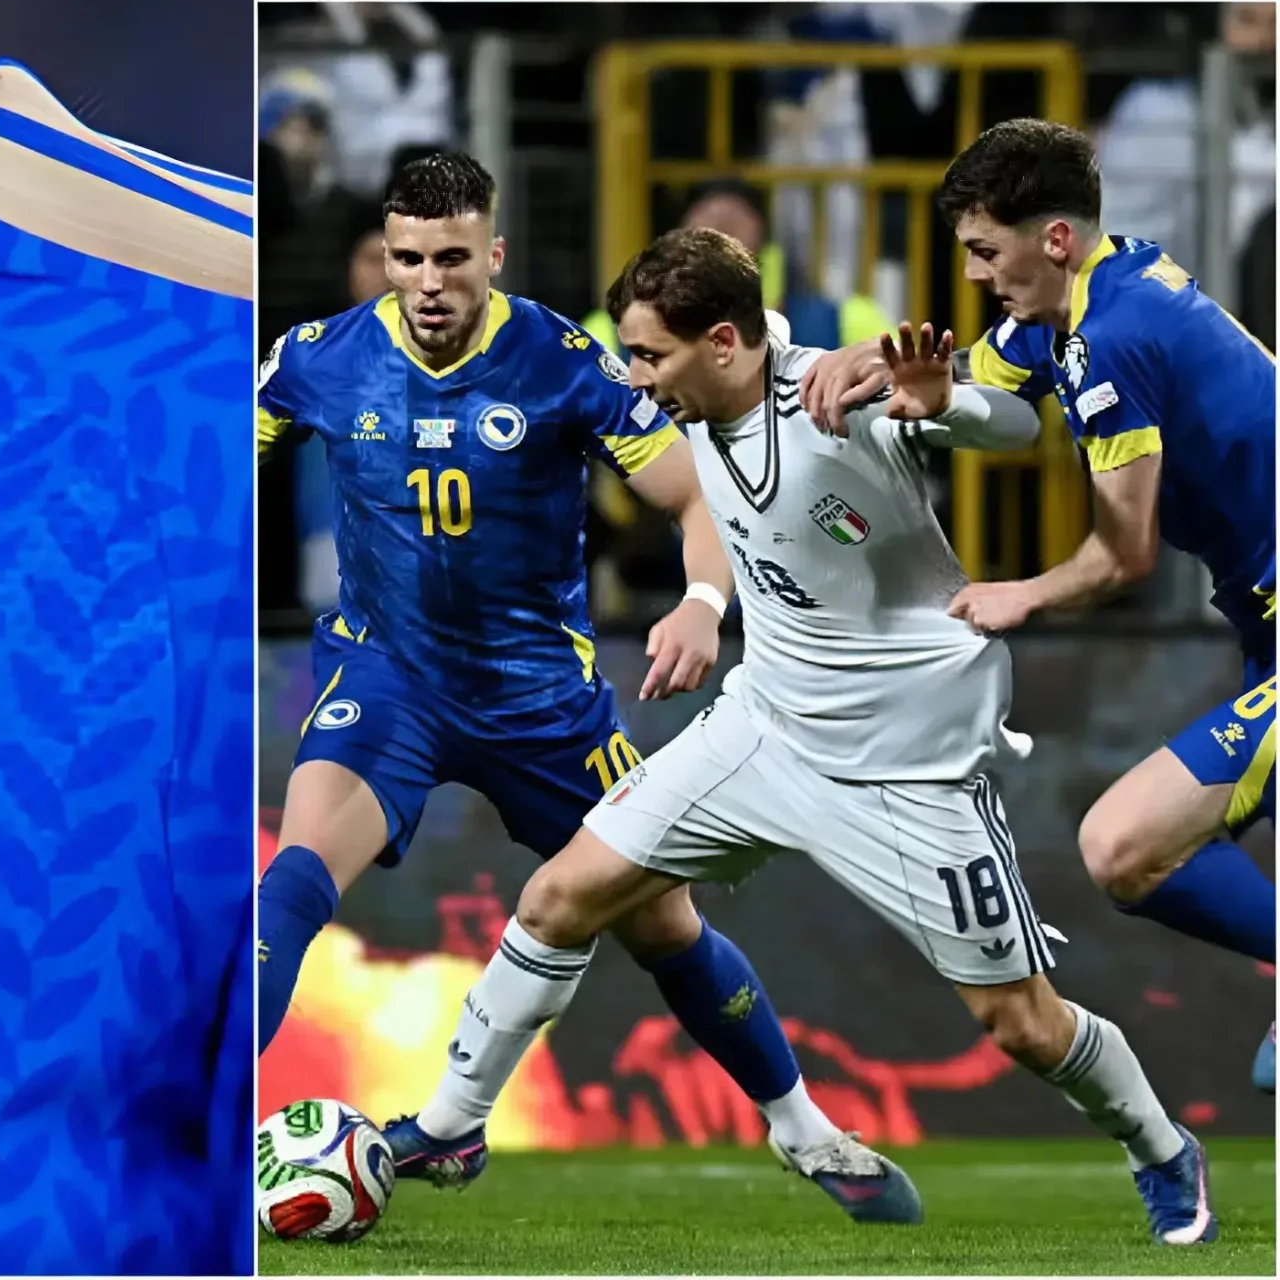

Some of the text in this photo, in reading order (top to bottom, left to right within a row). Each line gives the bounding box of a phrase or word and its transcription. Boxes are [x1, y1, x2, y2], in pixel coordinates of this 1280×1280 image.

[406, 468, 473, 537] 10
[585, 731, 637, 794] 10
[936, 854, 1011, 934] 18
